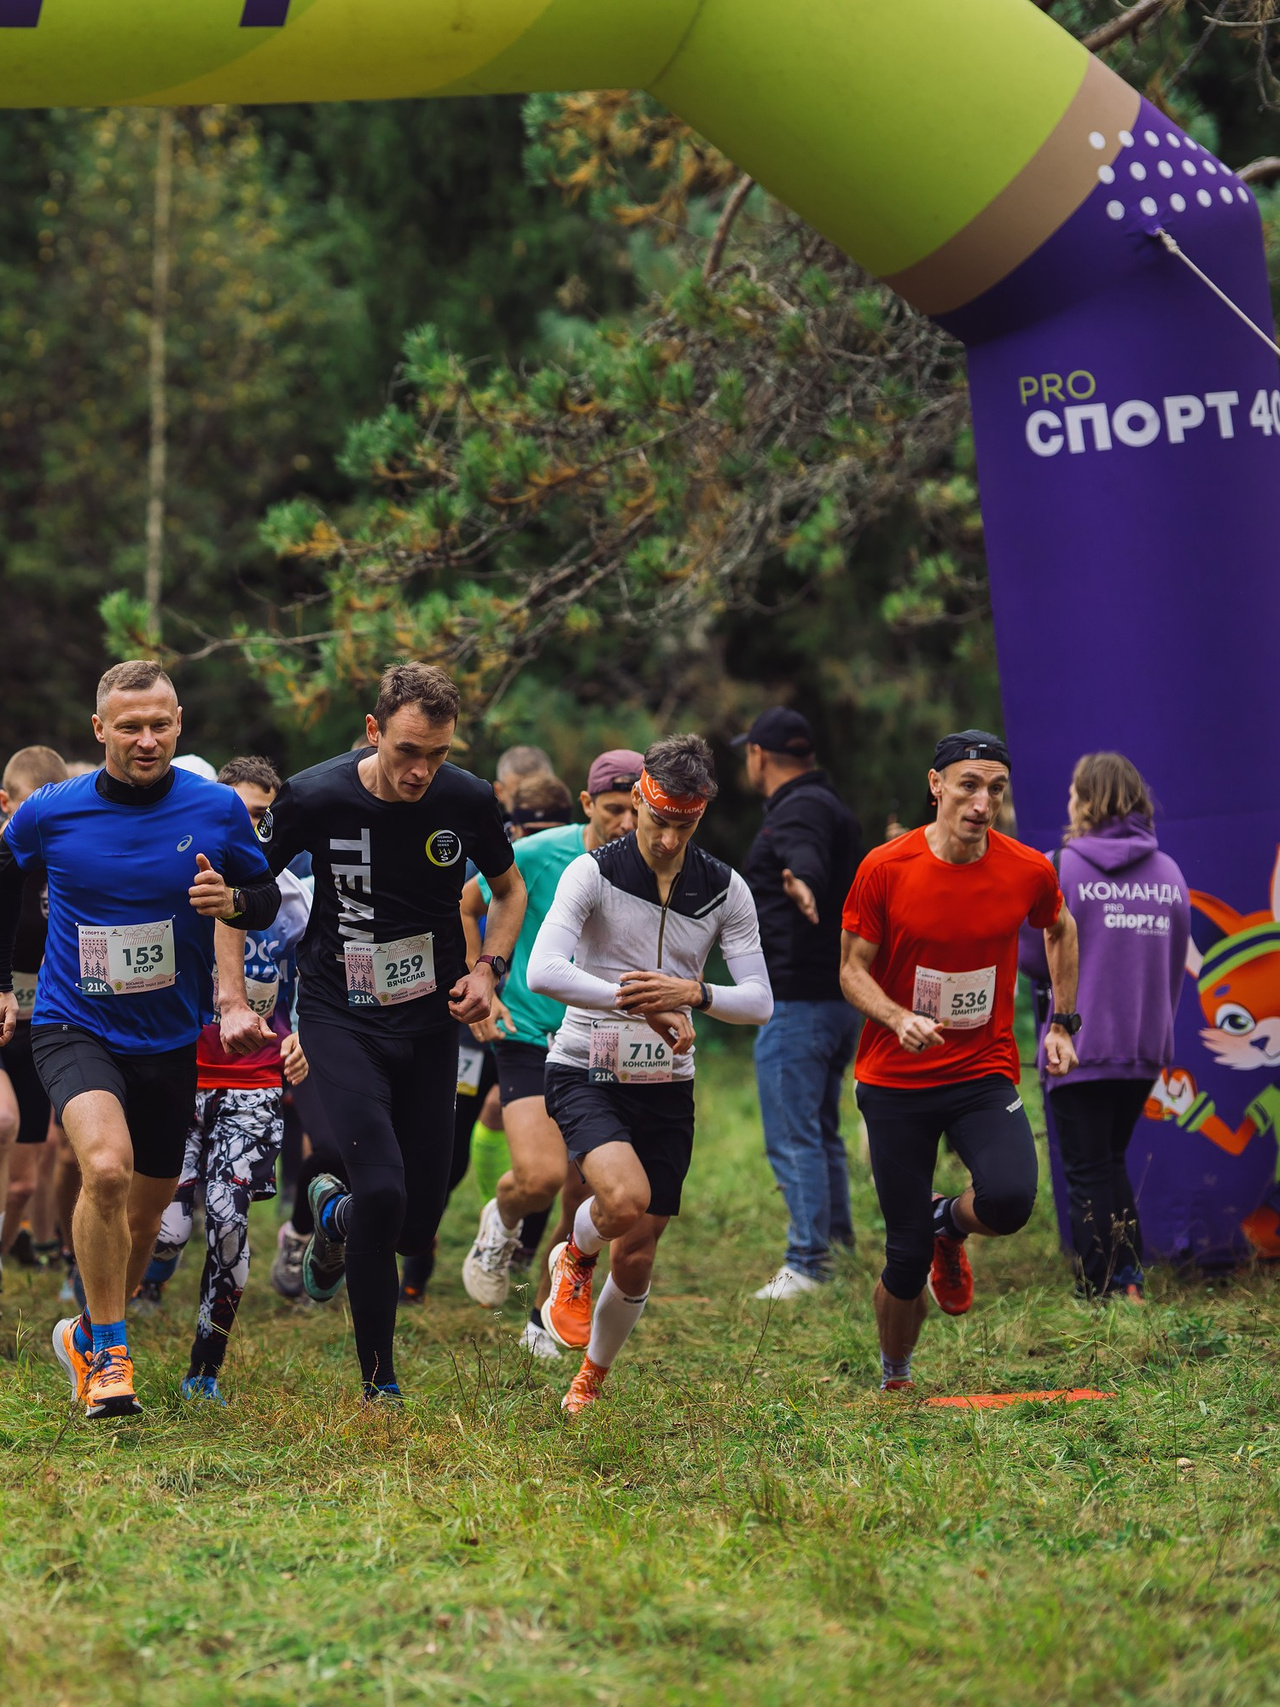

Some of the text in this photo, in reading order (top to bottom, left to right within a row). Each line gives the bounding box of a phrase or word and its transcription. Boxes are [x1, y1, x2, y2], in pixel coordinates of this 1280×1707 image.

[1019, 370, 1096, 406] PRO
[1026, 391, 1239, 457] СПОРТ
[1077, 881, 1183, 906] КОМАНДА
[1103, 903, 1125, 914] PRO
[1104, 913, 1171, 930] СПОРТ 40
[122, 944, 164, 966] 153
[133, 965, 154, 973] ЕГОР
[385, 954, 423, 980] 259
[387, 971, 426, 988] ВЯЧЕСЛАВ
[951, 989, 987, 1009] 536
[951, 1004, 986, 1016] ДМИТРИЙ
[629, 1042, 666, 1060] 716
[622, 1060, 670, 1068] КОНСТАНТИН
